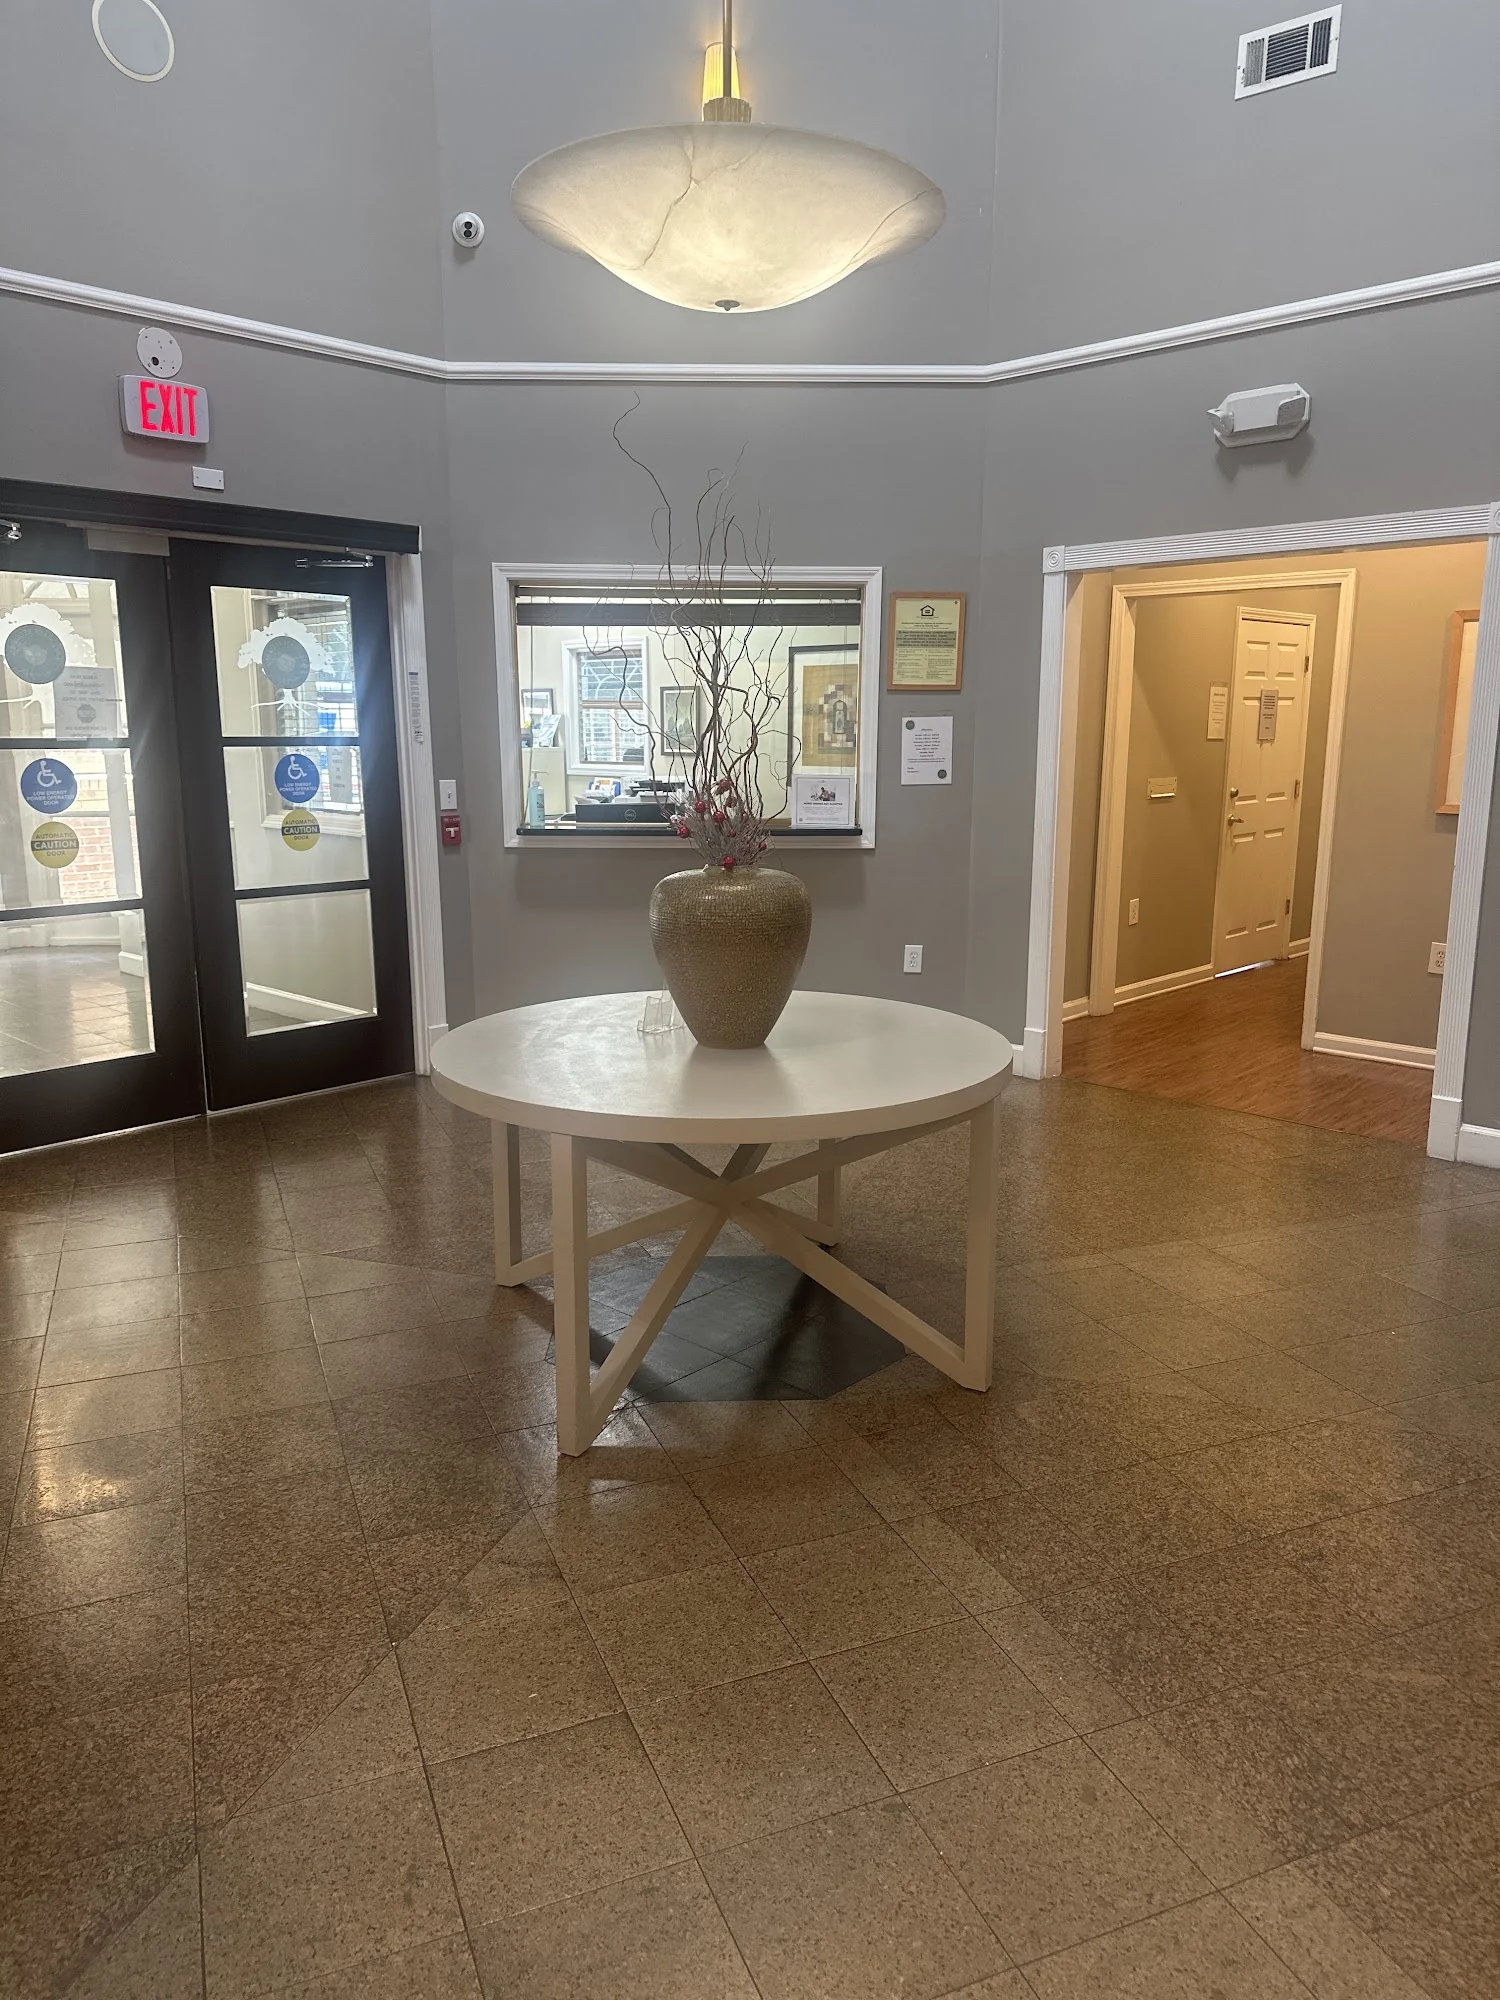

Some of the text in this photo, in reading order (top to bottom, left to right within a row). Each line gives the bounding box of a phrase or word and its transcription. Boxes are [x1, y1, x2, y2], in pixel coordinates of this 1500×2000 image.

[139, 380, 198, 438] EXIT
[284, 826, 318, 834] CAUTION
[34, 840, 77, 850] CAUTION
